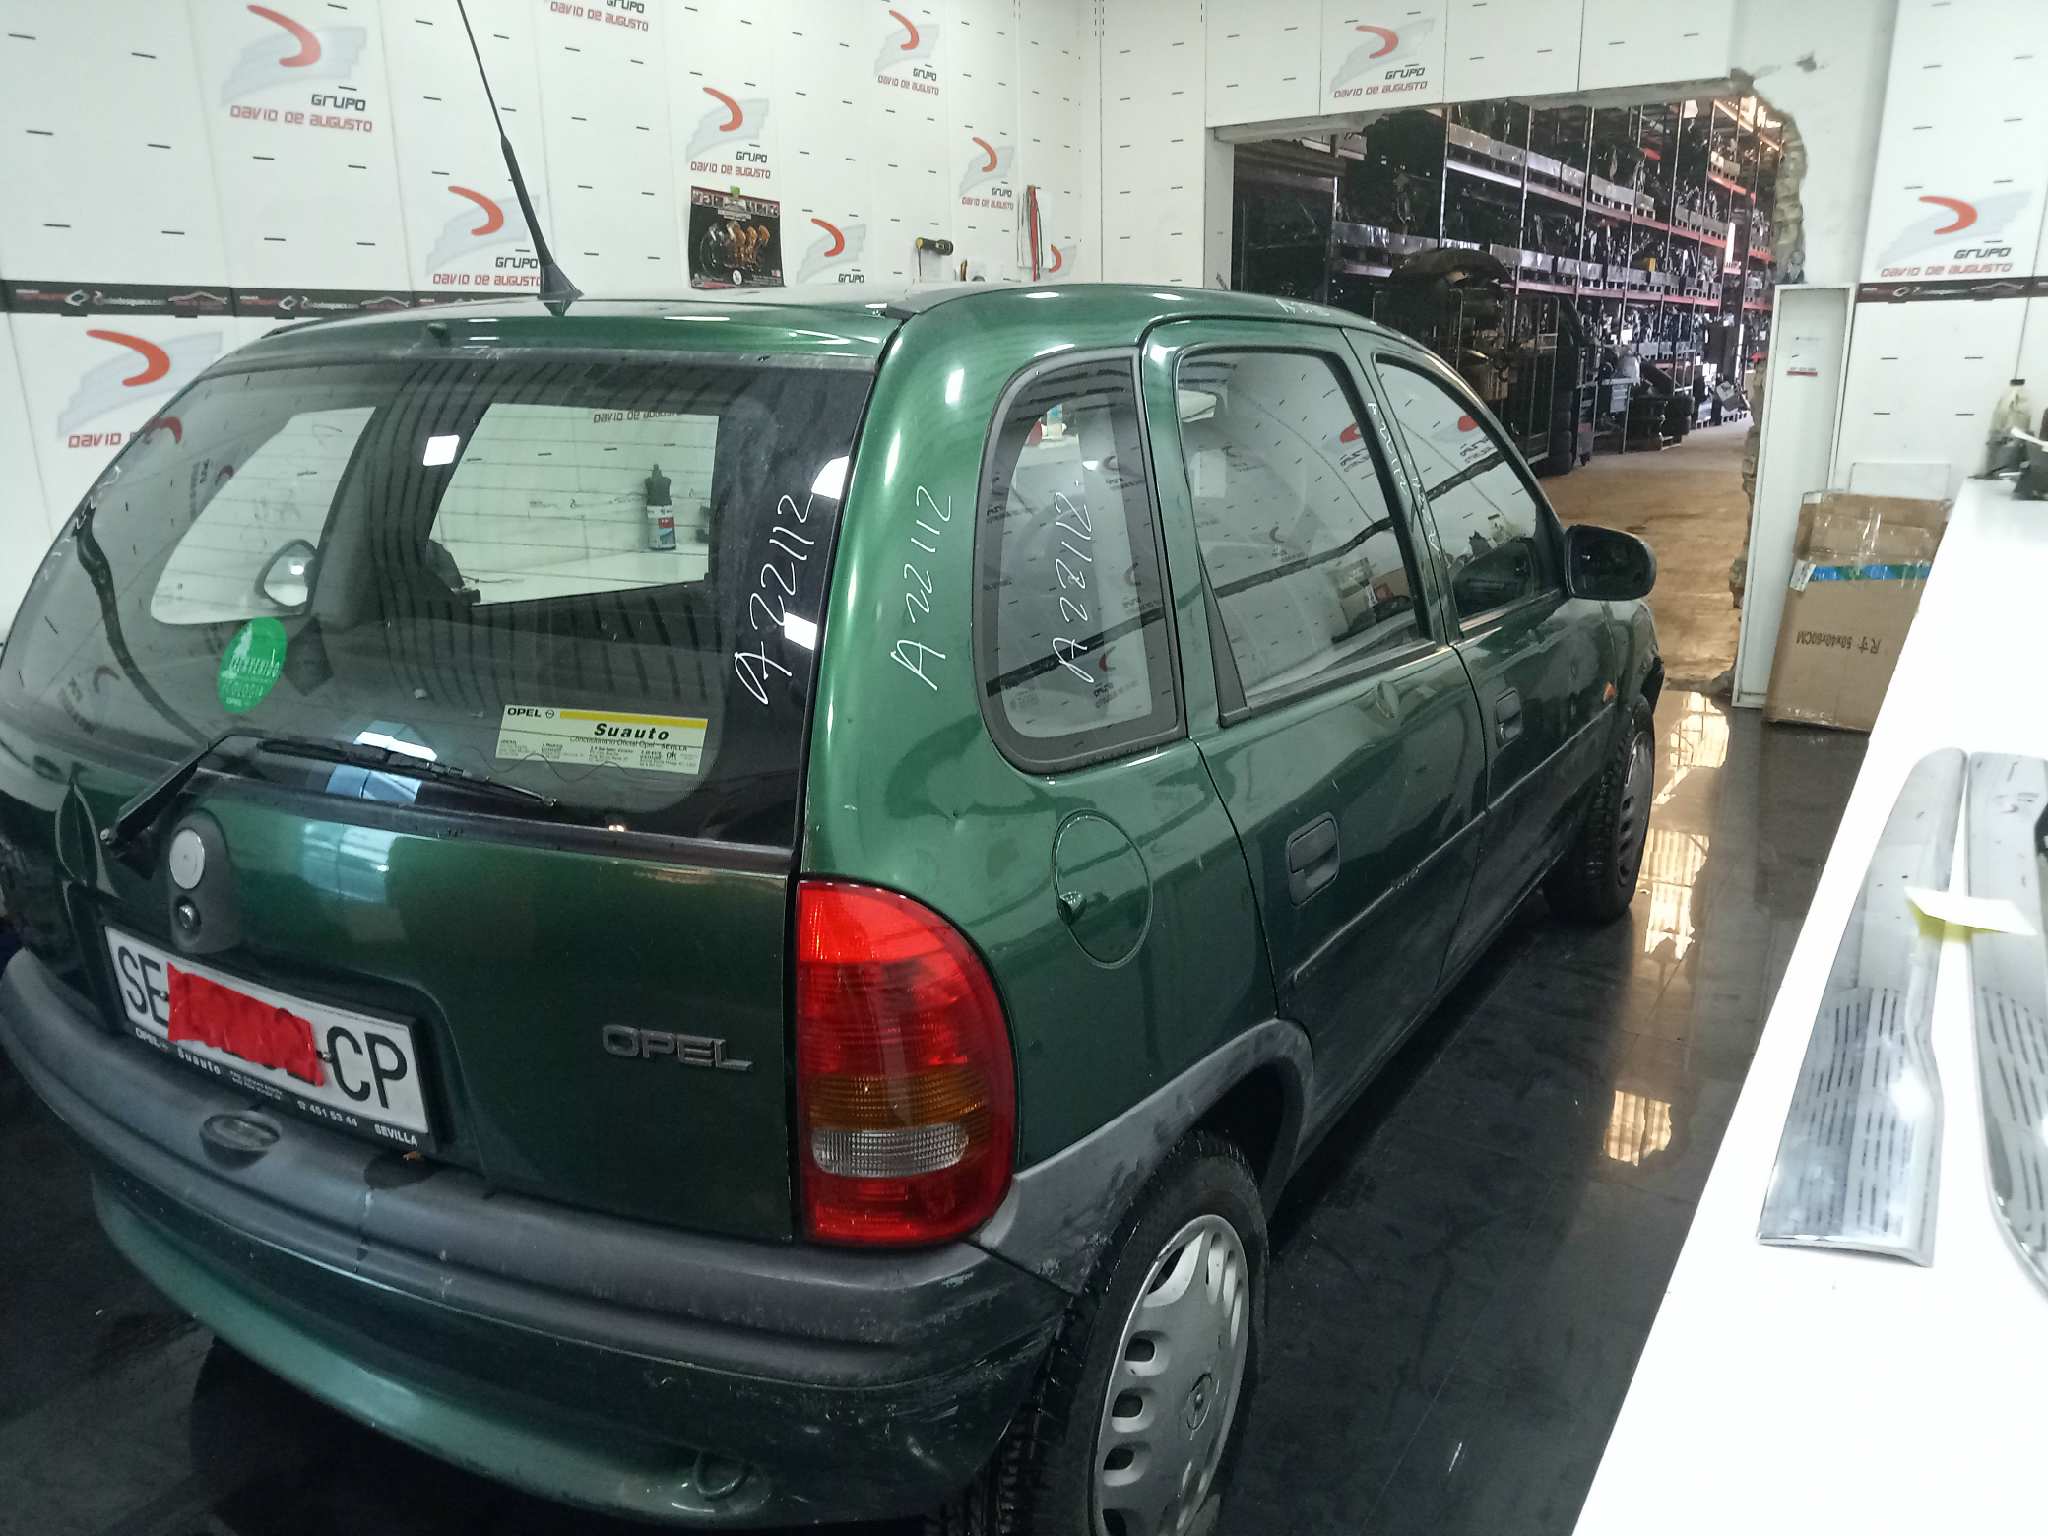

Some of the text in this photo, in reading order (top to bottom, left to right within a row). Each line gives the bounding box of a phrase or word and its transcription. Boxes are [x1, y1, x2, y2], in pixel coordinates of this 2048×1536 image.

[507, 707, 542, 718] OPEL
[594, 722, 670, 741] Suauto
[602, 1024, 752, 1072] OPEL
[326, 1025, 408, 1110] CP
[374, 1123, 418, 1147] SEVILLA
